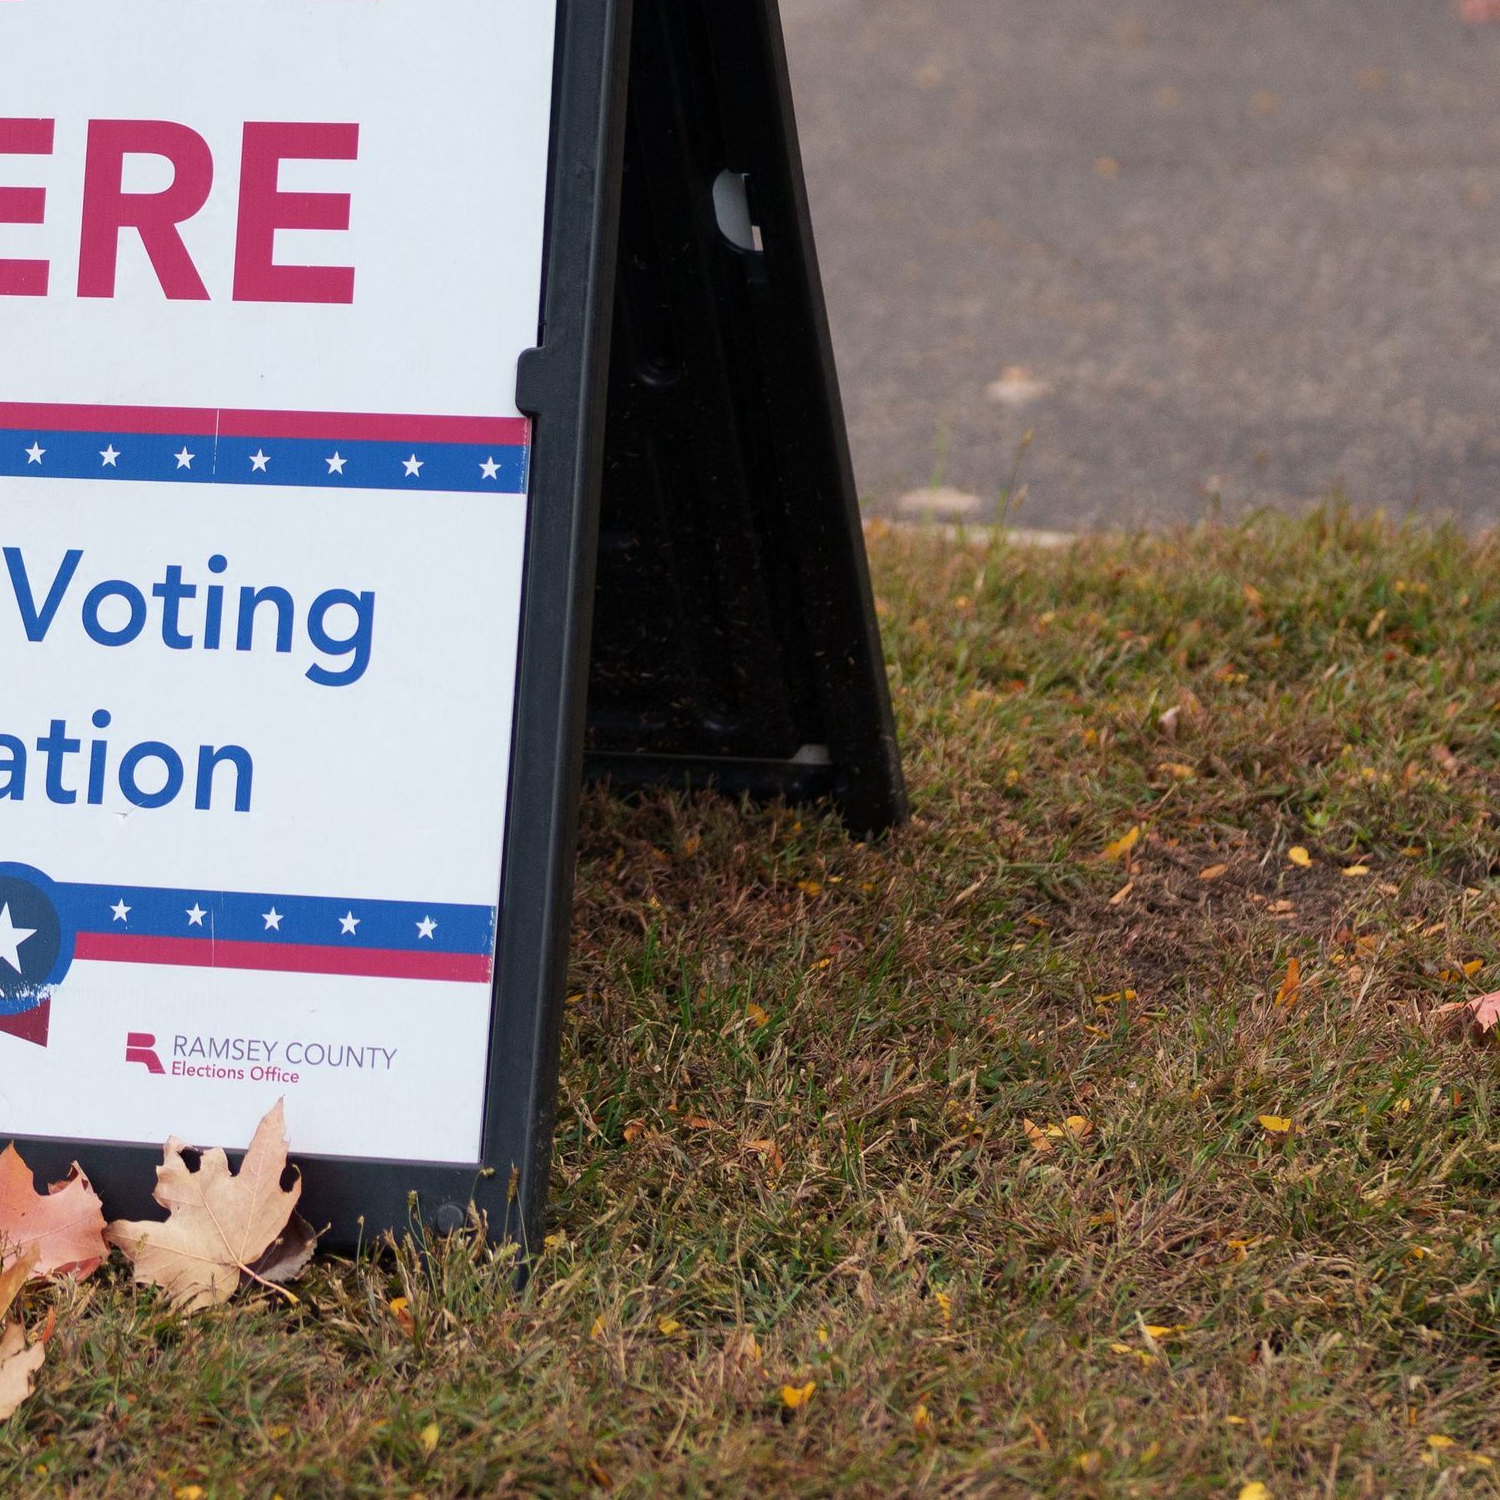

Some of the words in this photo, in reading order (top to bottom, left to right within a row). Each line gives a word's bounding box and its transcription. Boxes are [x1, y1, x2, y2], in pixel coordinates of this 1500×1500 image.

[2, 546, 376, 687] Voting
[173, 1035, 278, 1062] RAMSEY
[285, 1042, 398, 1070] COUNTY
[171, 1061, 244, 1080] Elections
[250, 1066, 299, 1083] Office
